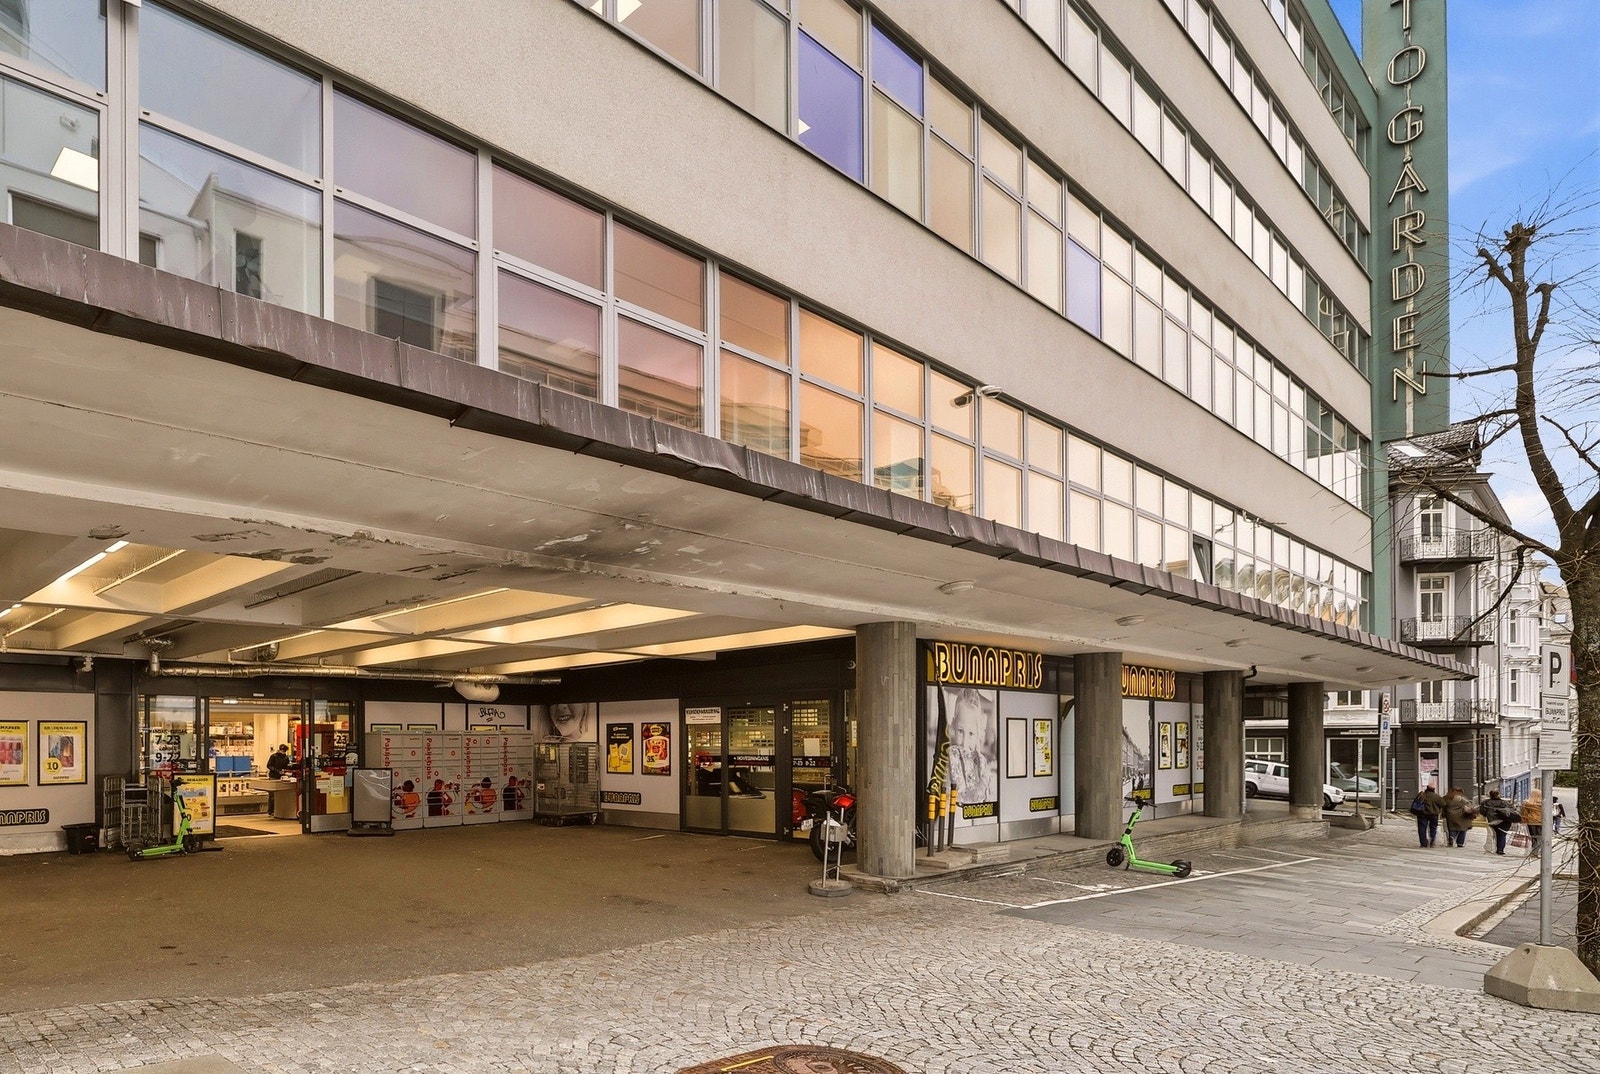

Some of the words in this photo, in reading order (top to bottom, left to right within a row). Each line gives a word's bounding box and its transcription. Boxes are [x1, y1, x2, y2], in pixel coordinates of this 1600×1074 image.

[935, 642, 1043, 690] BUNNPRIS
[1121, 665, 1176, 700] UNNPRIS
[1549, 652, 1562, 688] P
[155, 735, 181, 745] 7-23
[47, 762, 59, 770] 10
